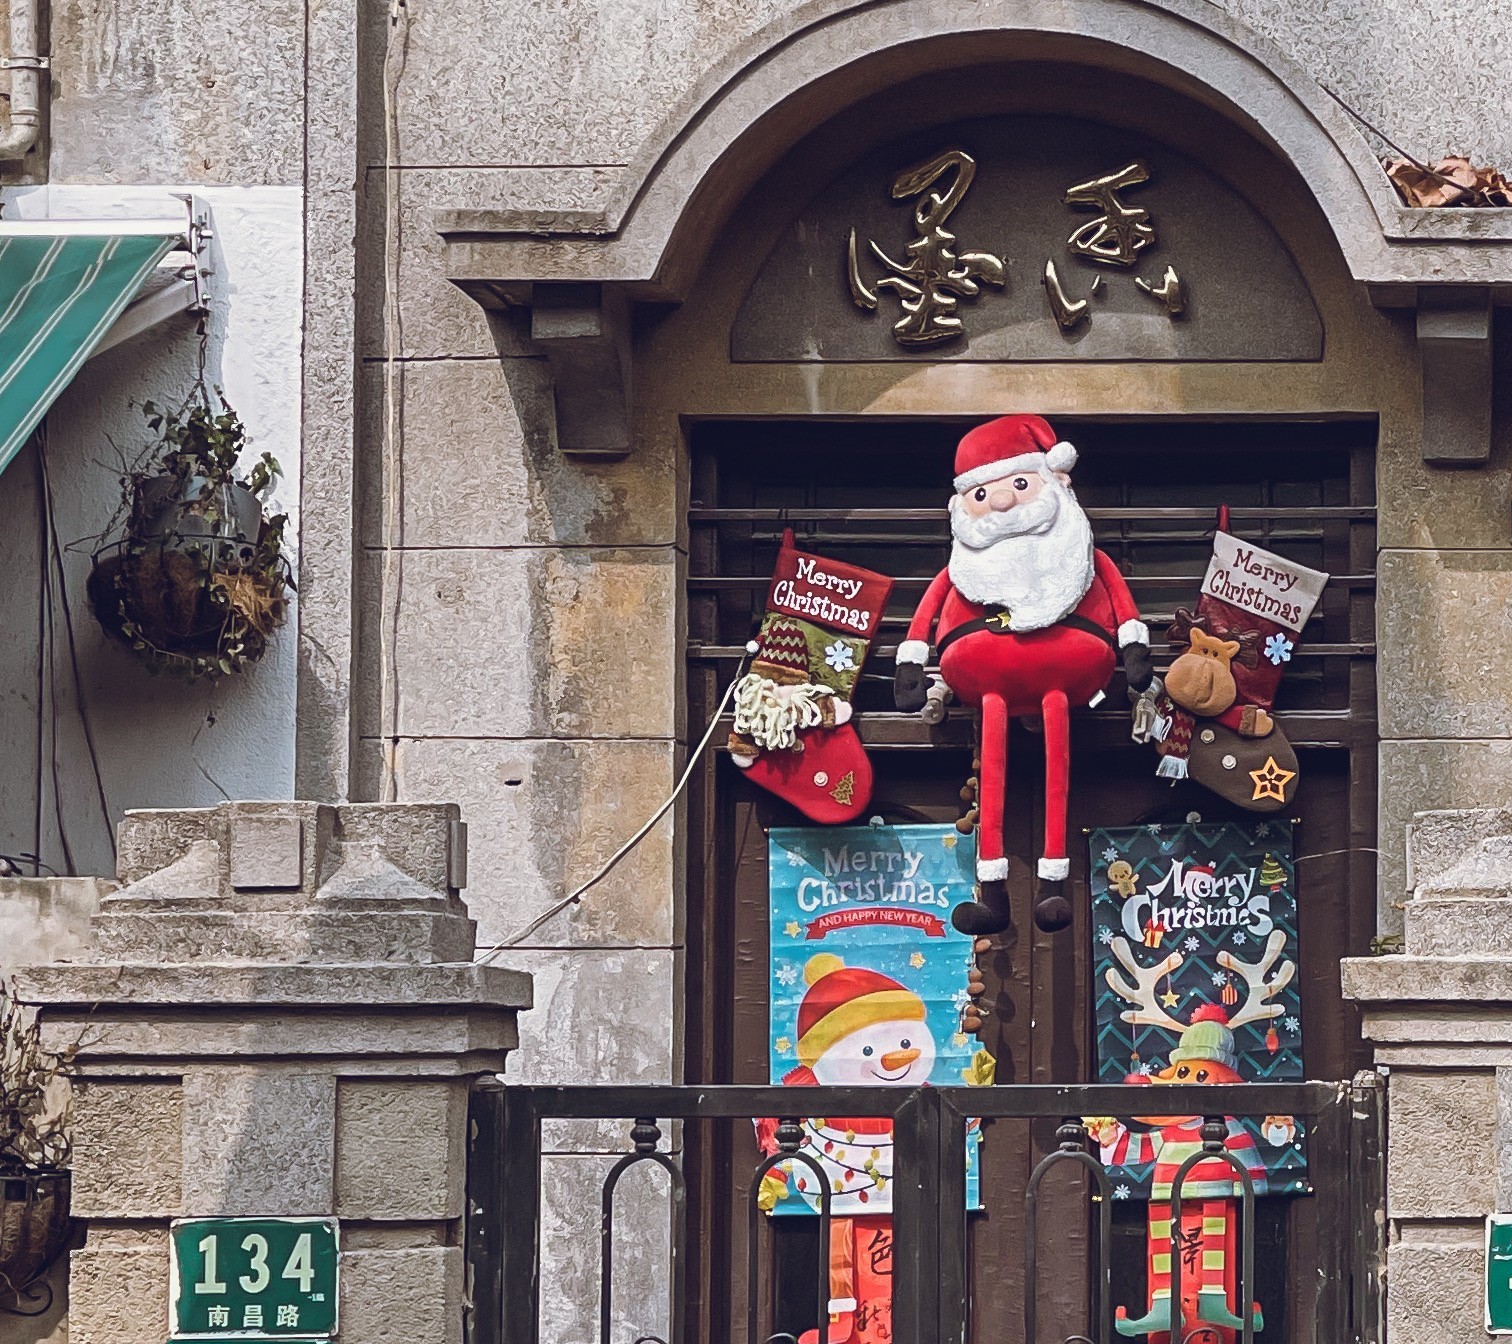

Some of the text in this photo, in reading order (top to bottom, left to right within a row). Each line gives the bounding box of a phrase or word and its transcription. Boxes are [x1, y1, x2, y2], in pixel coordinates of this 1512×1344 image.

[796, 557, 863, 600] Merry
[1233, 547, 1299, 593] Merry
[773, 580, 870, 631] Christmas
[1209, 569, 1302, 624] Christmas
[821, 844, 924, 878] Merry
[1146, 858, 1257, 906] Merry
[797, 874, 950, 912] Christmas
[818, 910, 932, 929] AND HAPPY NEW YEAR
[1121, 891, 1274, 943] Christmas
[194, 1233, 315, 1294] 134
[207, 1304, 300, 1328] 南昌路
